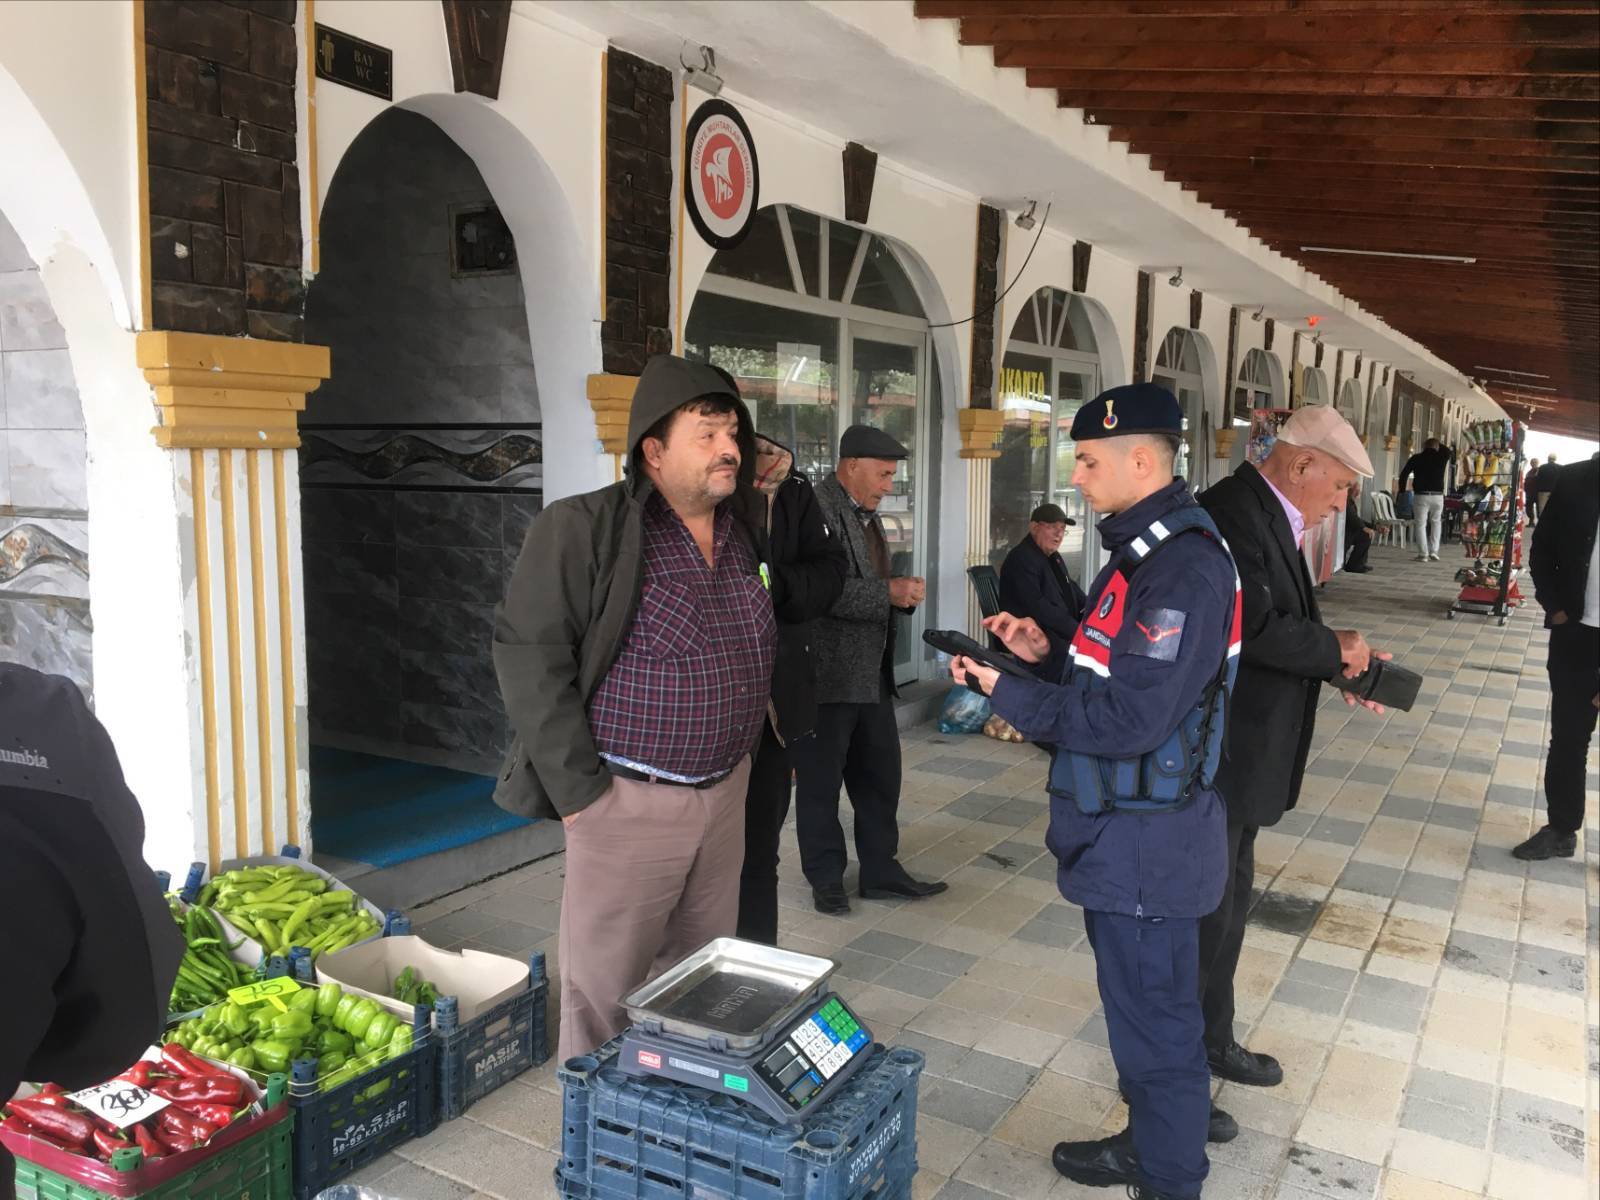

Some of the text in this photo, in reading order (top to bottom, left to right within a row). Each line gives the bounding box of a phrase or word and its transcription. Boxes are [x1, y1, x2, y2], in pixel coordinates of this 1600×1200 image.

[354, 64, 374, 82] WC
[999, 367, 1045, 401] OKANTA
[0, 748, 49, 769] umbia
[808, 1021, 818, 1033] 3
[808, 1047, 817, 1058] 4
[814, 1041, 824, 1053] 5
[821, 1035, 831, 1047] 6
[827, 1056, 838, 1068] 8
[834, 1050, 844, 1062] 9
